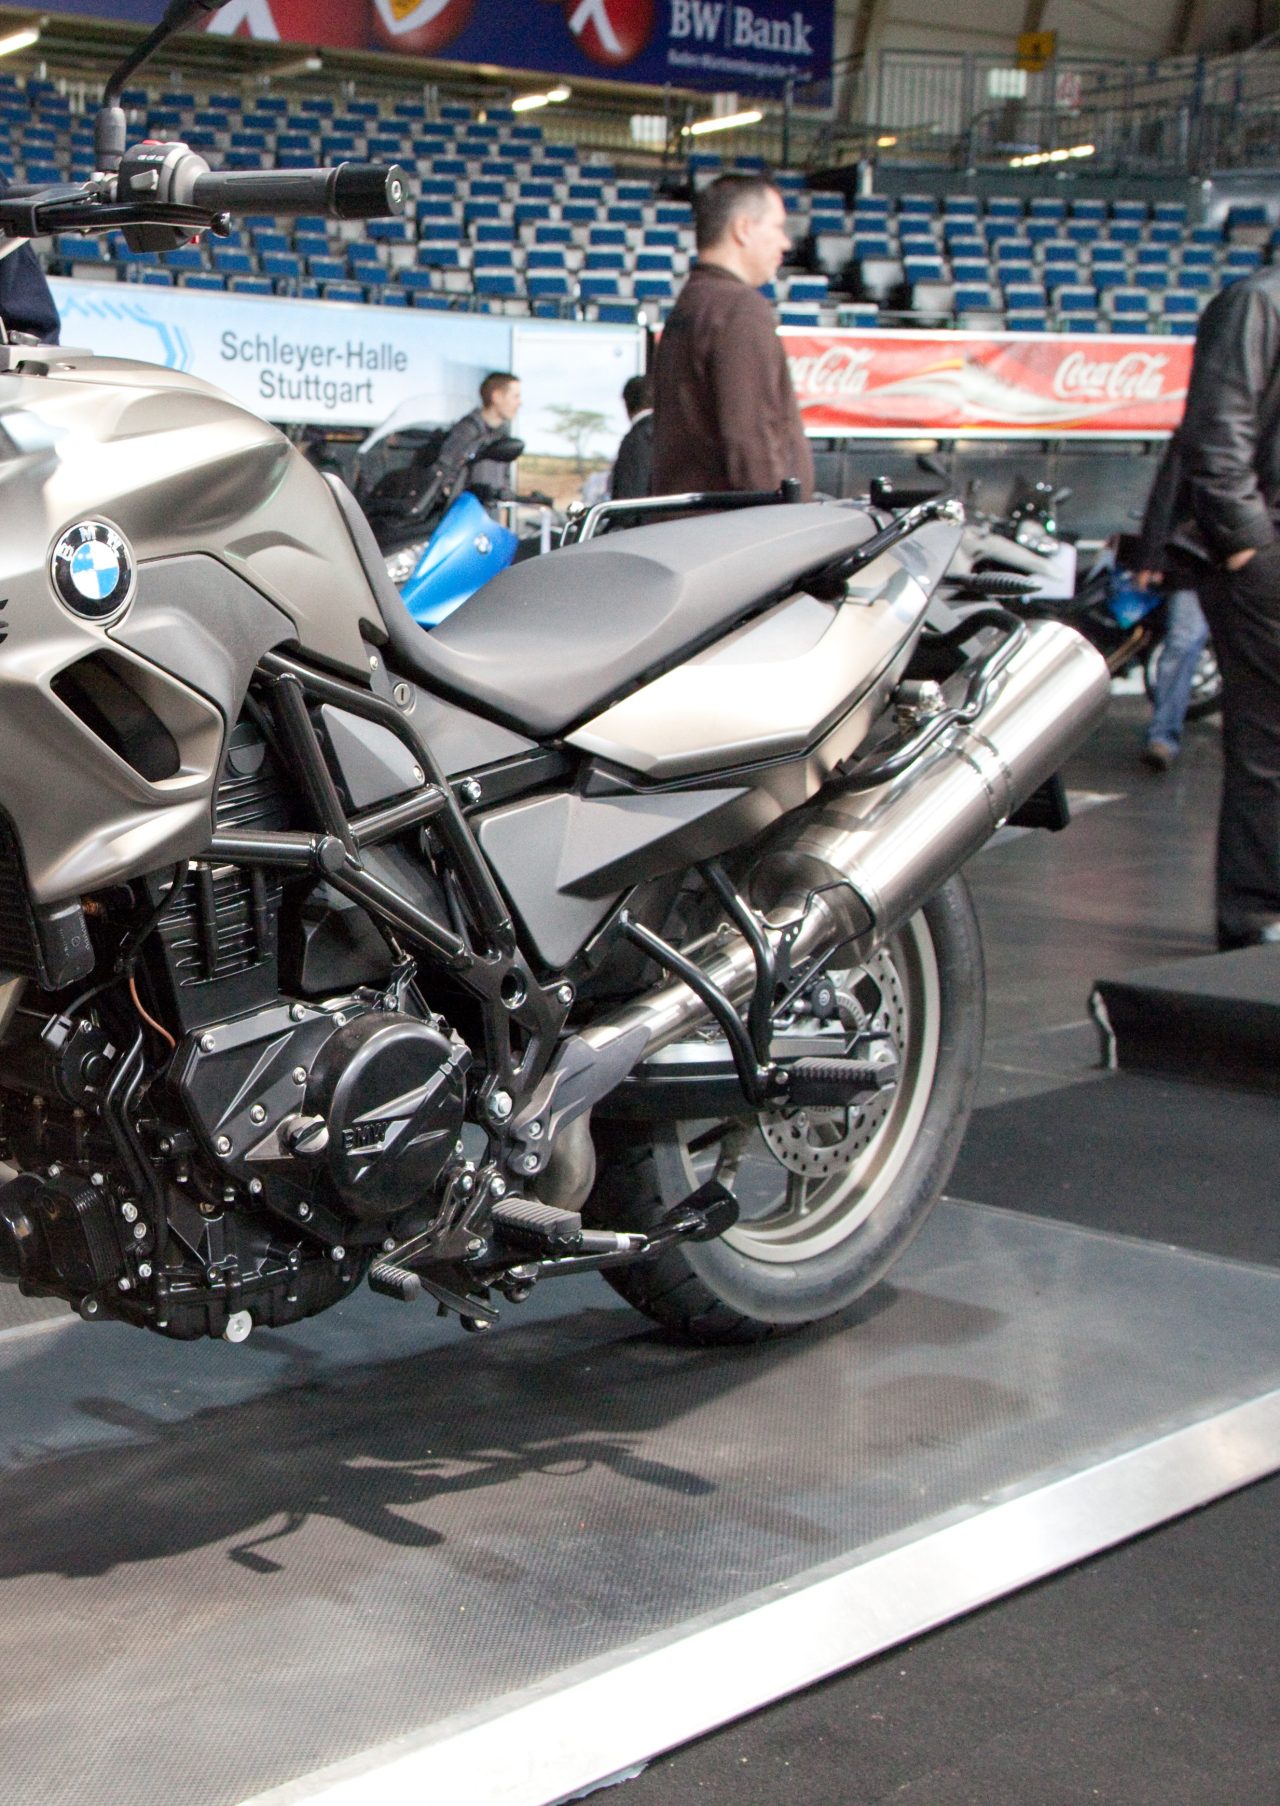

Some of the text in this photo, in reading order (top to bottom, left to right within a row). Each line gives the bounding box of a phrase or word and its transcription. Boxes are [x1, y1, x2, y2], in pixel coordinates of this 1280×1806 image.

[669, 0, 814, 55] BW Bank
[220, 331, 408, 372] Schleyer-Halle
[259, 370, 374, 409] Stuttgart
[342, 1122, 389, 1149] BMW
